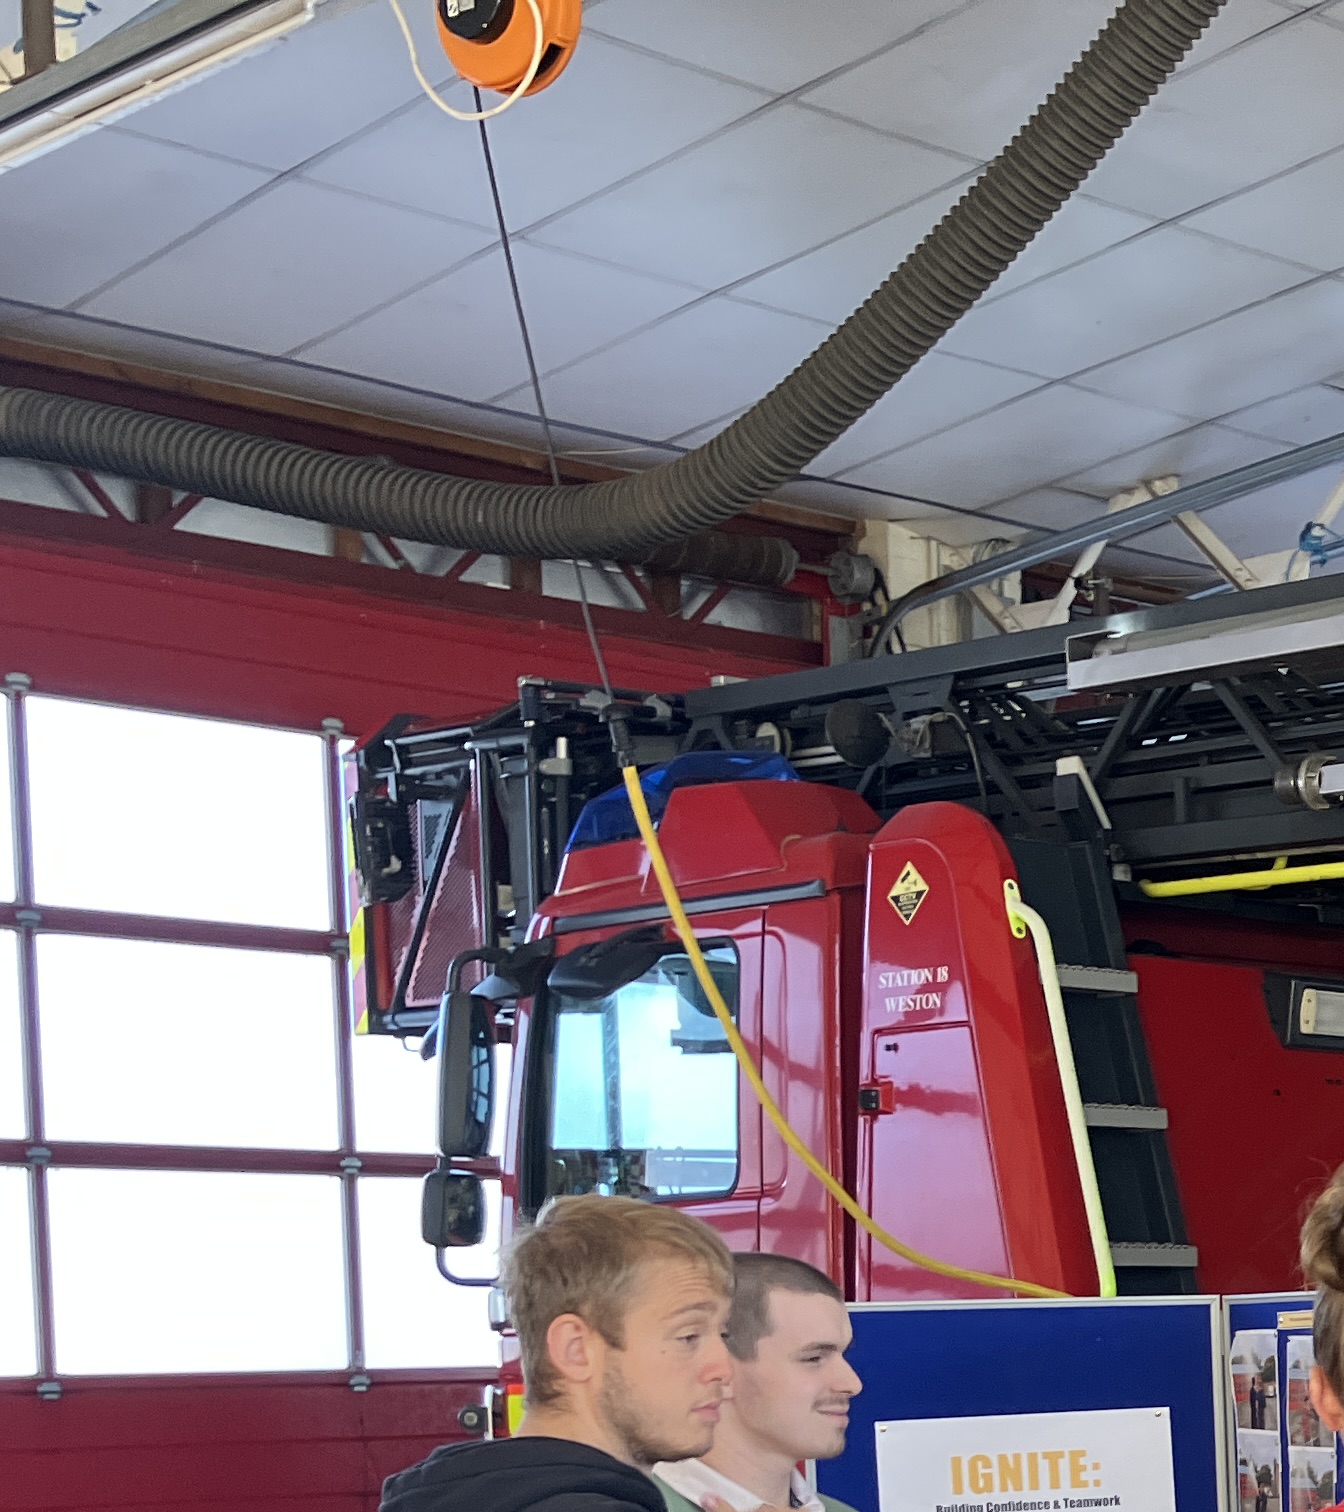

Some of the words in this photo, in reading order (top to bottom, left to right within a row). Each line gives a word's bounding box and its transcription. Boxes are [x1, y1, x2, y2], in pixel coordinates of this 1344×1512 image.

[878, 968, 934, 989] STATION
[936, 966, 949, 983] 18
[884, 992, 942, 1013] WESTON
[951, 1449, 1102, 1495] IGNITE:
[986, 1500, 1051, 1512] Confidence
[1053, 1500, 1060, 1509] &
[1063, 1495, 1121, 1509] Teamwork
